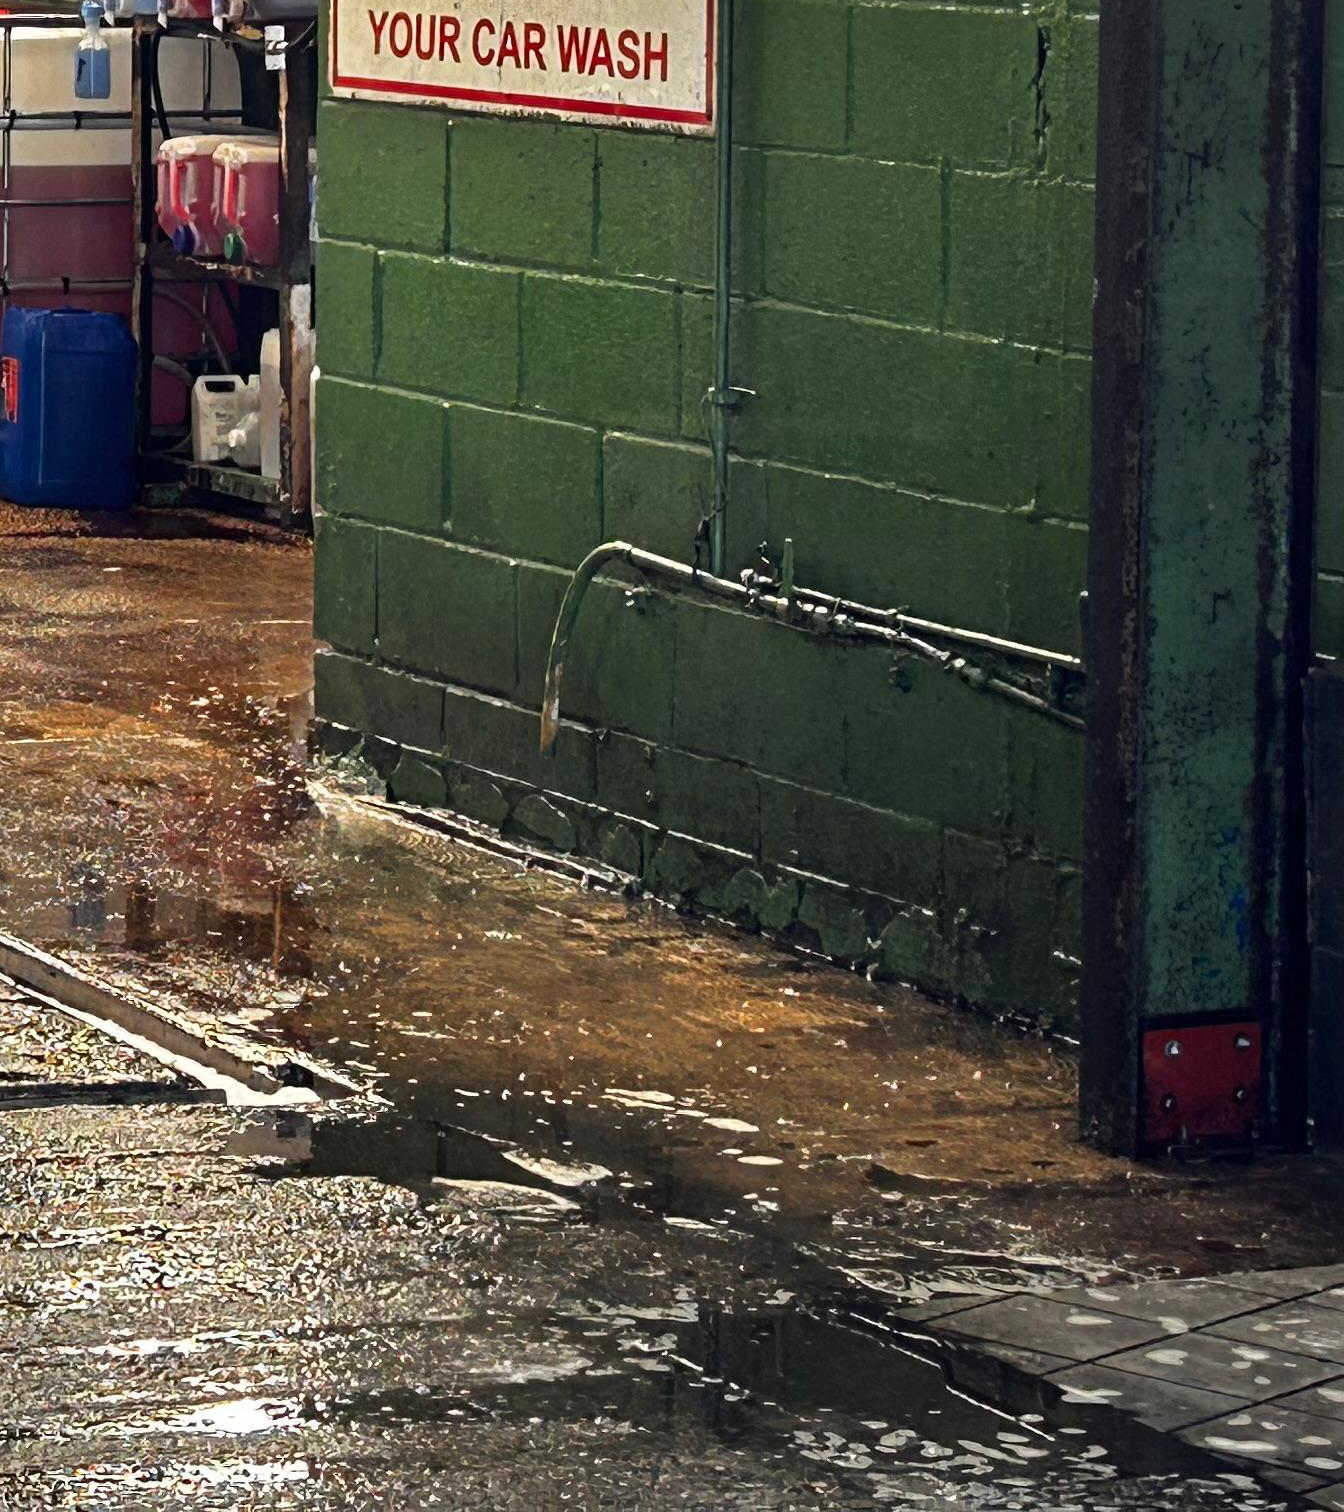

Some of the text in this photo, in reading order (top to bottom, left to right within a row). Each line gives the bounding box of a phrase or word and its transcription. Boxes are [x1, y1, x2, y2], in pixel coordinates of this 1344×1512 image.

[368, 10, 668, 82] YOUR CAR WASH
